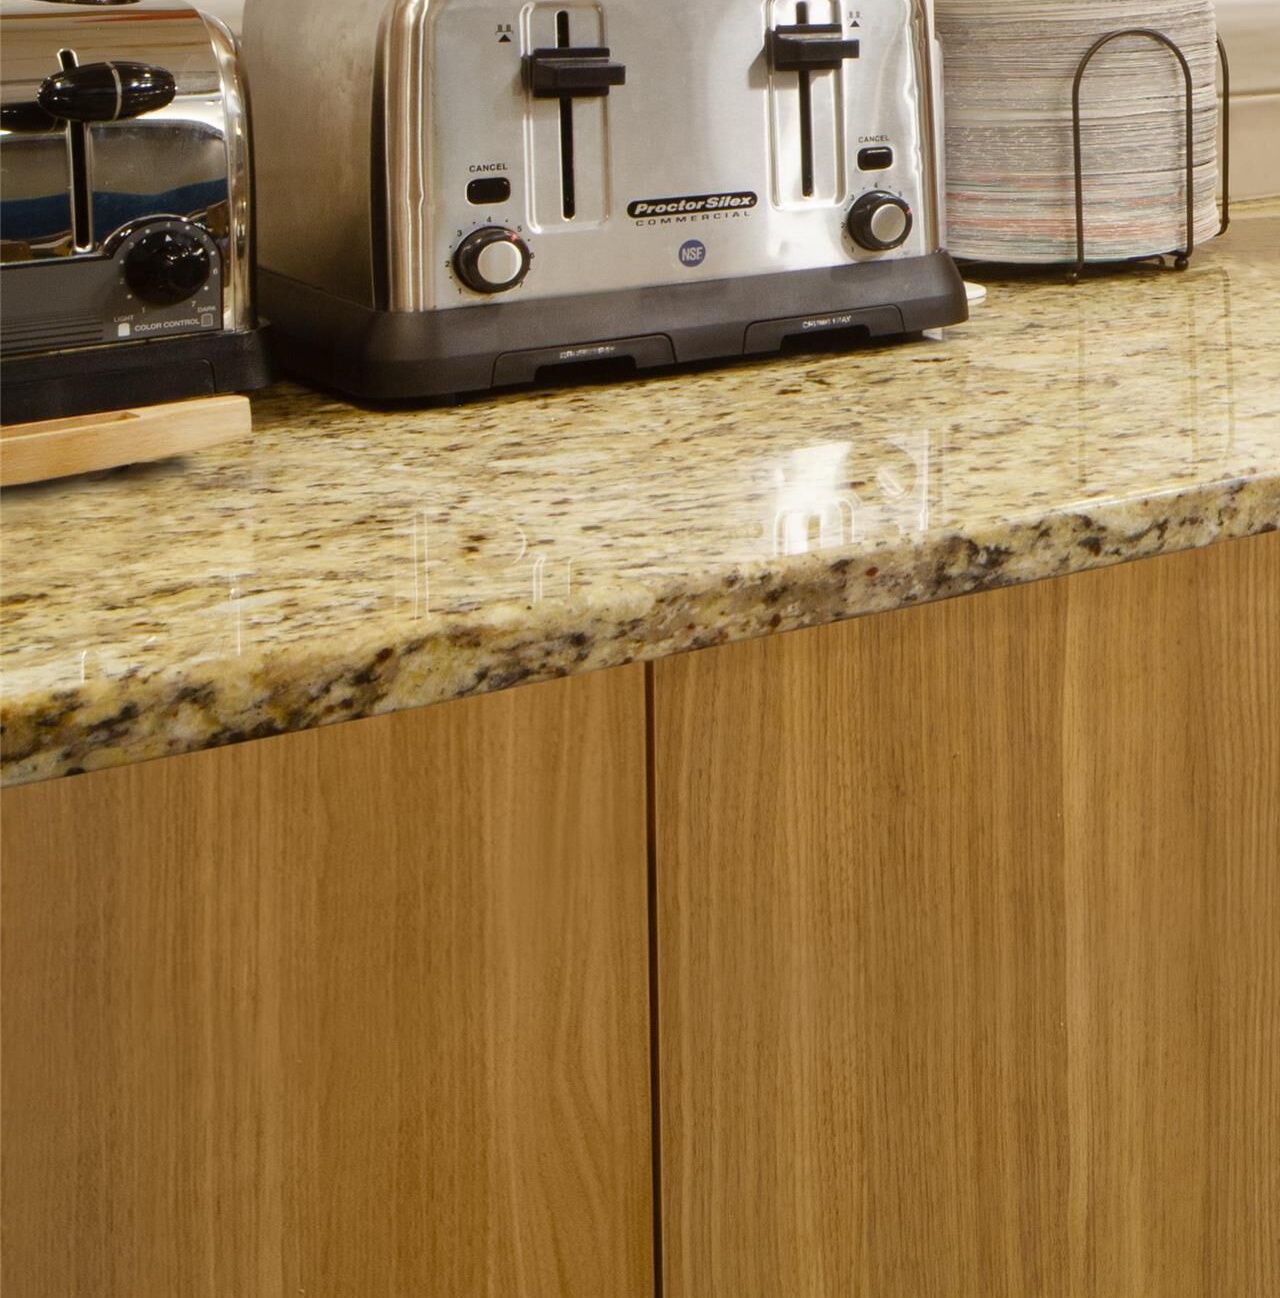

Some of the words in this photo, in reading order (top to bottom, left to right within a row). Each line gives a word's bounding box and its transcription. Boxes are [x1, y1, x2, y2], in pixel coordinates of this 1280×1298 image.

[857, 135, 890, 144] CANCEL
[468, 163, 509, 173] CANCEL
[634, 195, 753, 216] ProctorSilex
[635, 212, 751, 227] COMMERCIAL
[681, 246, 704, 262] NSF
[197, 305, 217, 313] DARK
[113, 314, 135, 323] LIGHT
[134, 322, 162, 333] COLOR
[163, 317, 200, 329] CONTROL
